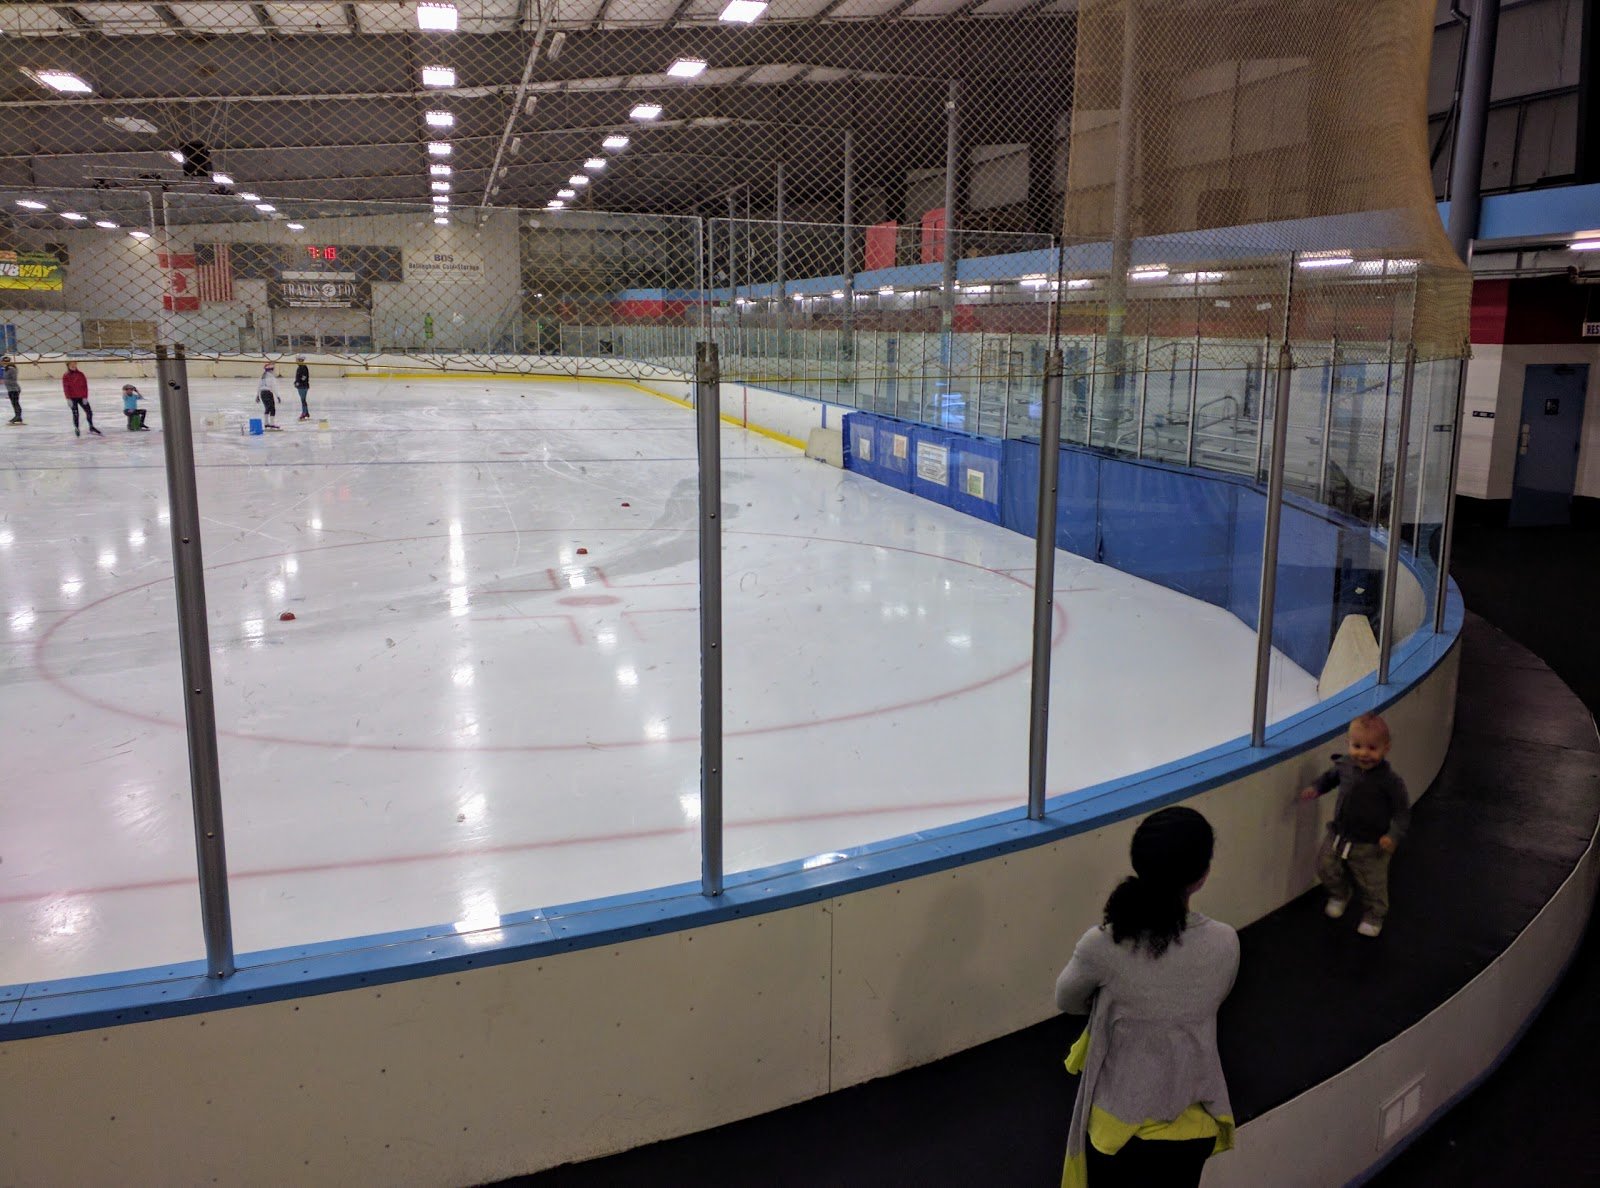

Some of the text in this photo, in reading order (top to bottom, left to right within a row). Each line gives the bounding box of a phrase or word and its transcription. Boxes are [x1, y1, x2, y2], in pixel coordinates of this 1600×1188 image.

[0, 263, 58, 278] UBWAY
[281, 283, 357, 297] TRAVIS FOX
[1586, 324, 1600, 335] RES
